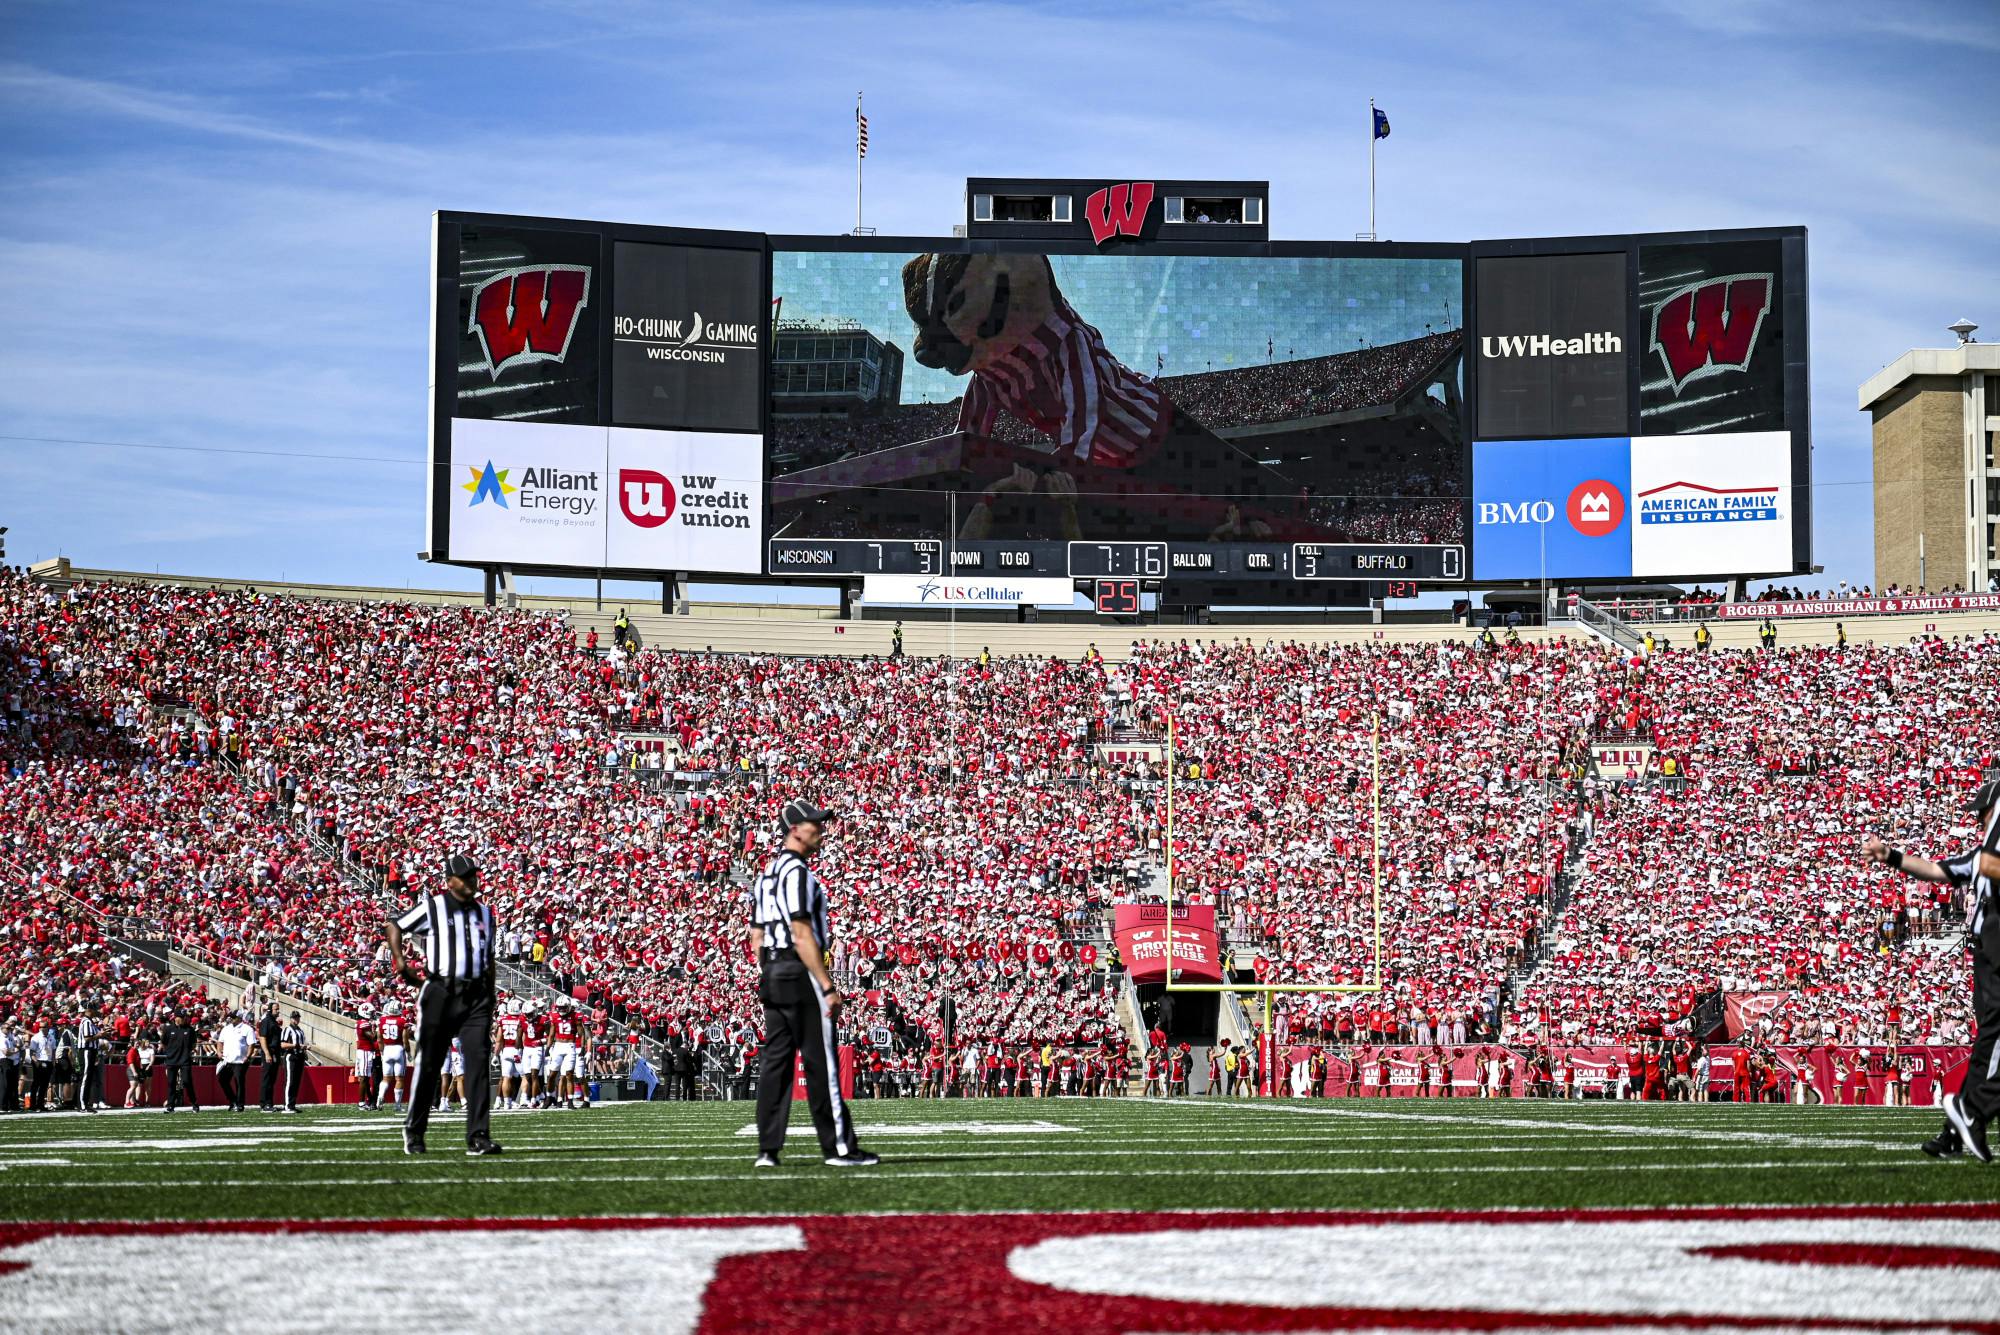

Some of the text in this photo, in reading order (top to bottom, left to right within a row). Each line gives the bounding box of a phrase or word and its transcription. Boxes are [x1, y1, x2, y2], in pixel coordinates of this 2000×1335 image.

[1085, 182, 1154, 246] W
[468, 263, 592, 383] W
[614, 316, 757, 343] HO-CHUNK GAMING
[1649, 272, 1774, 398] W
[647, 347, 725, 364] WISCONSIN
[520, 467, 598, 491] Alliant
[681, 475, 716, 489] uw
[520, 491, 595, 515] Energy
[681, 491, 749, 509] credit
[1641, 495, 1777, 511] AMERICAN FAMILY
[681, 511, 751, 528] union
[1478, 501, 1555, 524] BMO
[1651, 510, 1766, 522] INSURANCE
[520, 516, 595, 528] Powering Beyond
[913, 542, 937, 552] T.O.L.
[1299, 546, 1321, 556] T.O.L.
[777, 550, 833, 564] WISCONSIN
[867, 543, 883, 570] 7
[920, 553, 931, 573] 3
[950, 551, 981, 565] DOWN
[1000, 552, 1030, 566] TO GO
[1098, 545, 1160, 574] 7:16
[1173, 554, 1211, 567] BALL ON
[1248, 554, 1271, 568] QTR.
[1357, 555, 1406, 569] BUFFALO
[1442, 549, 1459, 576] 0
[1305, 557, 1316, 576] 3
[944, 587, 1023, 600] U.S. Cellular
[1099, 582, 1137, 611] 25
[1387, 581, 1417, 598] 1:27
[1726, 603, 1778, 616] ROGER
[1781, 601, 1881, 615] MANSUKHANI
[1885, 600, 1897, 611] &
[1901, 597, 1954, 610] FAMILY
[1113, 752, 1122, 762] L
[1628, 751, 1637, 761] N
[1132, 941, 1207, 953] PROTECT
[1132, 949, 1205, 960] THIS HOUSE
[1365, 1068, 1412, 1077] AMICAN
